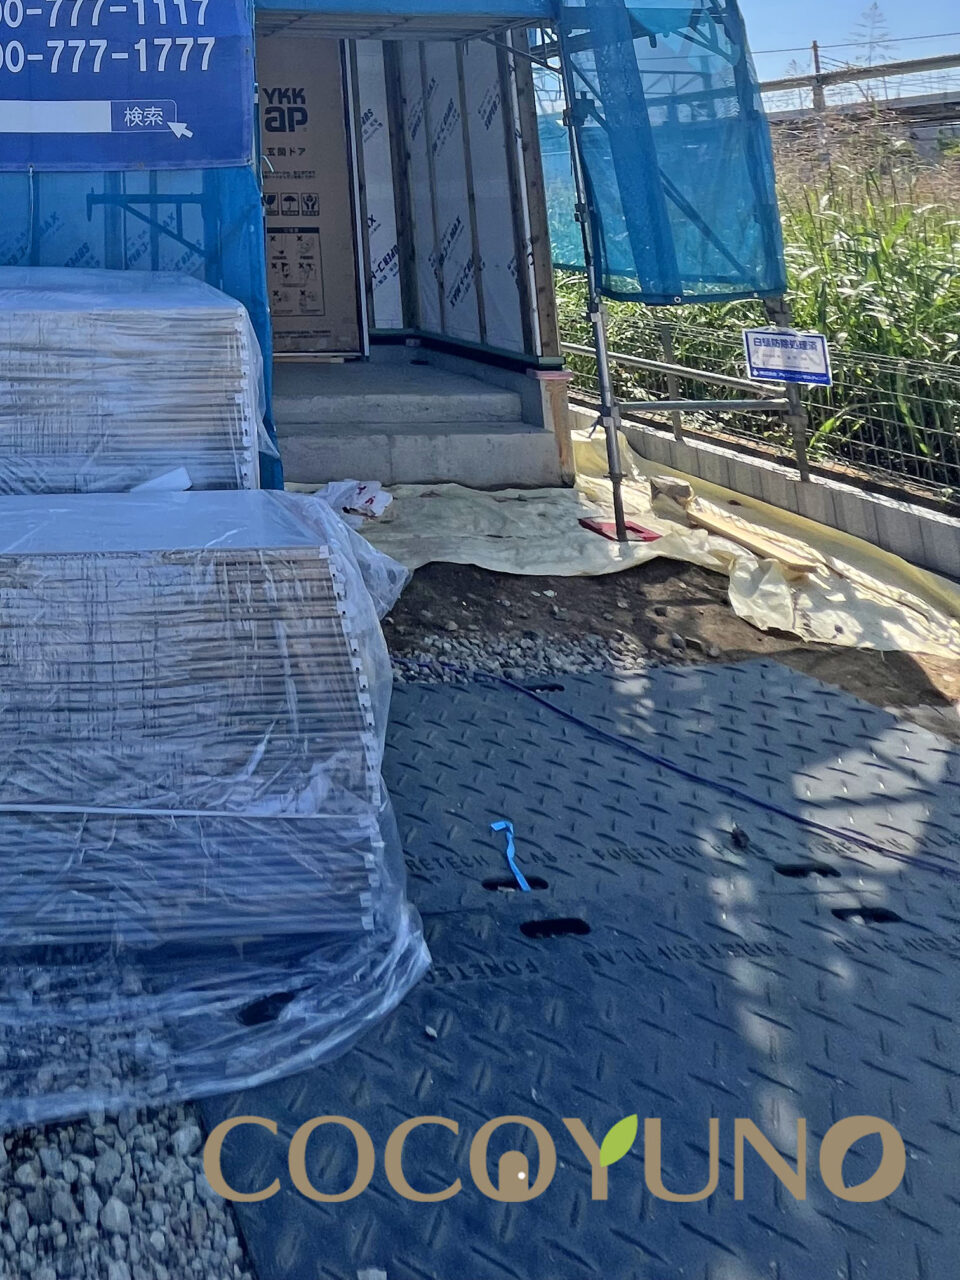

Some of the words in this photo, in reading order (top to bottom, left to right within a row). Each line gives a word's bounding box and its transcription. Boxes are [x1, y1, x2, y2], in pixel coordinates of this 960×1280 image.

[261, 87, 306, 105] YKK
[123, 106, 164, 127] 検索
[266, 146, 307, 157] 玄関ドア
